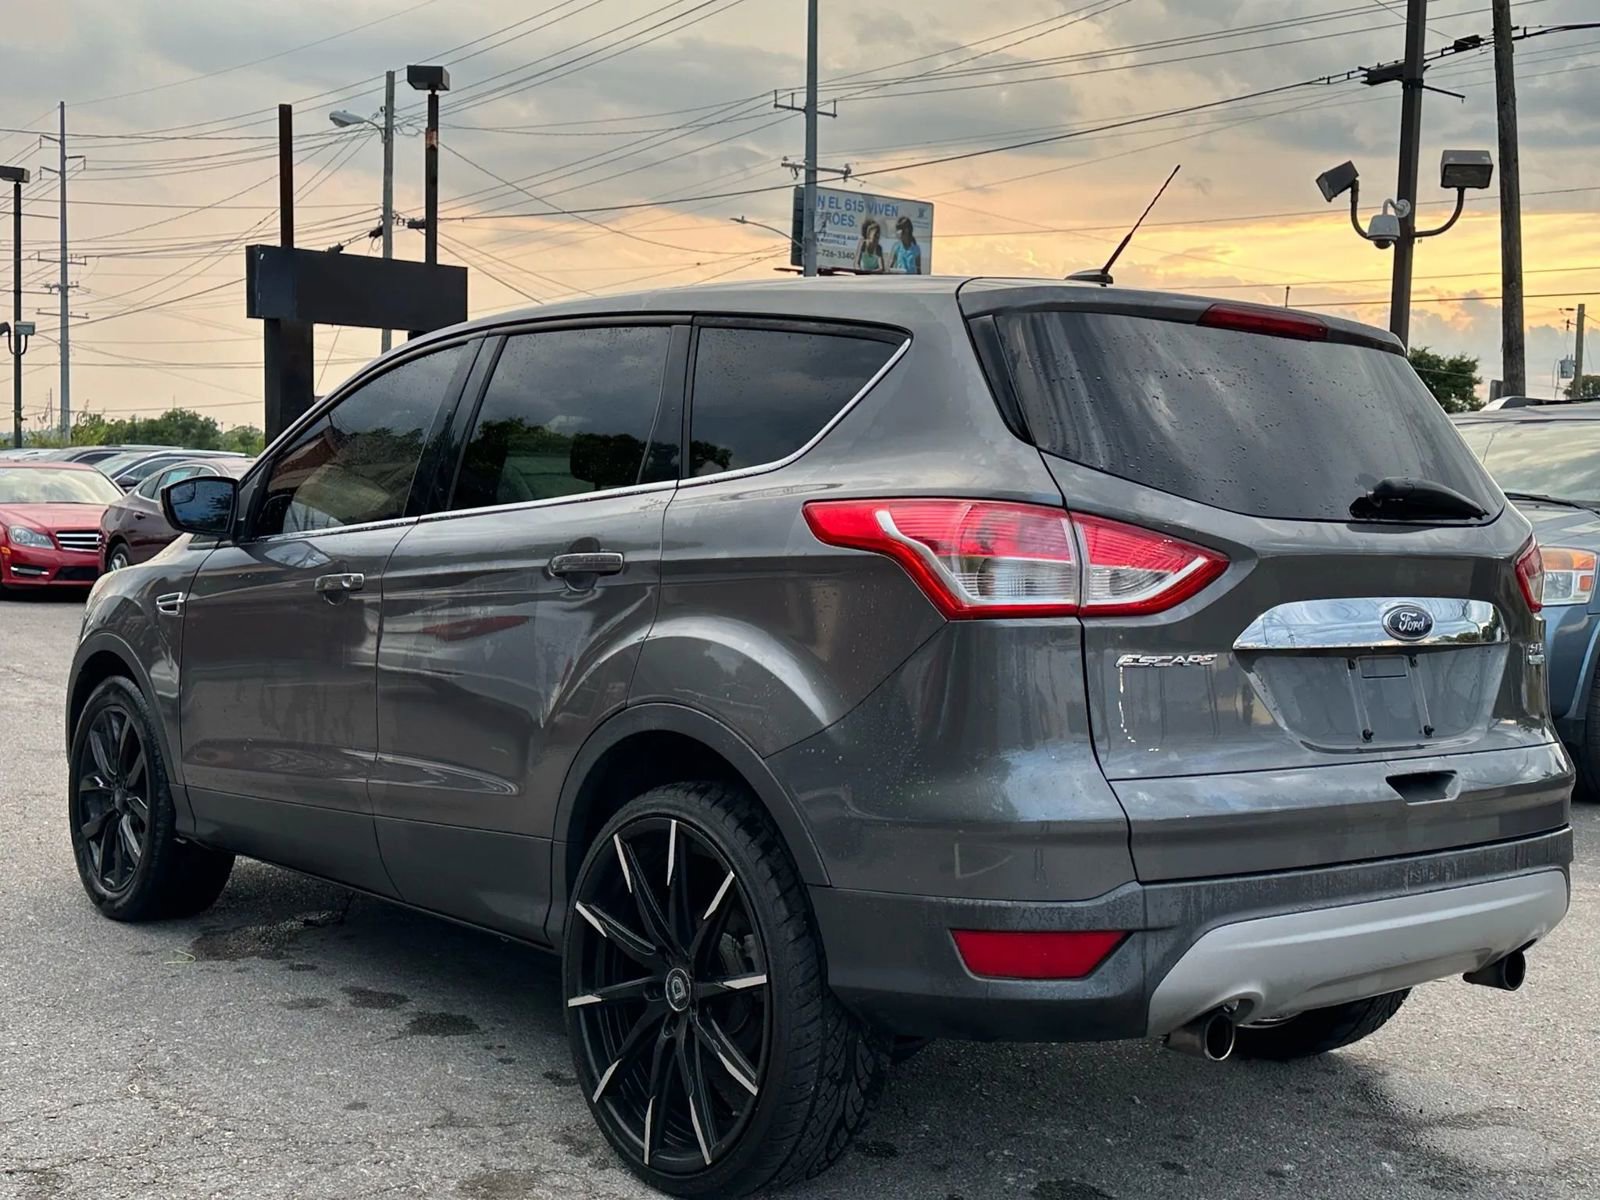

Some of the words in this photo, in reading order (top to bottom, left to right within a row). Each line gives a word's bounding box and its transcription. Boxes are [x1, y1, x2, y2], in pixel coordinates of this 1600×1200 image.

[828, 196, 842, 210] EL
[844, 199, 865, 213] 615
[868, 202, 899, 217] VIVEN
[1398, 611, 1425, 632] Ford
[1114, 653, 1218, 668] ESCAPE
